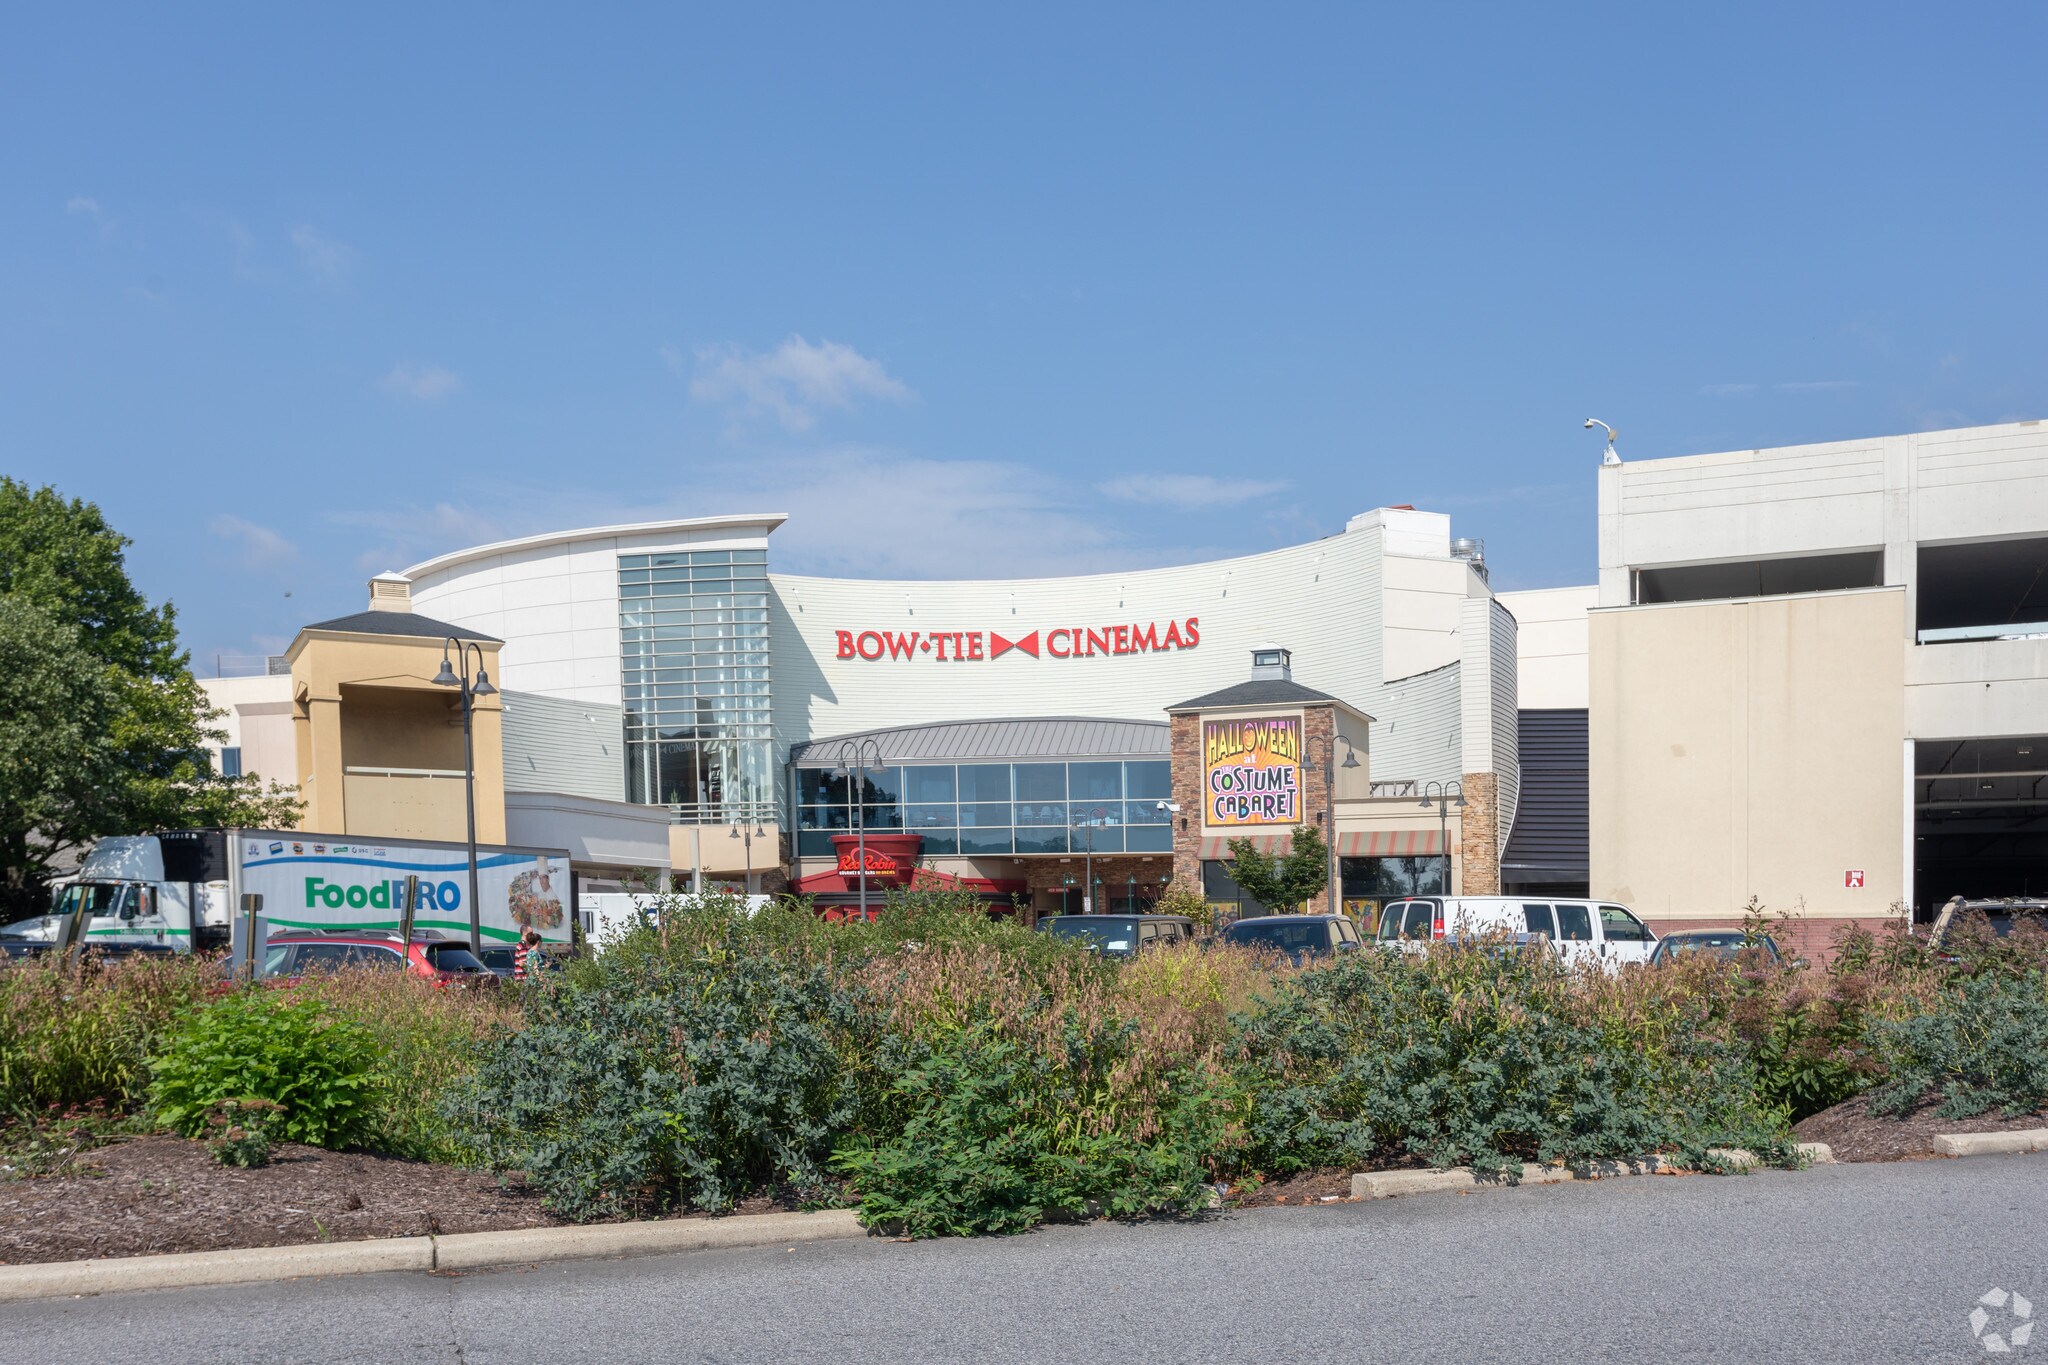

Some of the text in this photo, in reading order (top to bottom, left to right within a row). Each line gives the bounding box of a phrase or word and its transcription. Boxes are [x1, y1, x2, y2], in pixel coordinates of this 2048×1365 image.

[1047, 617, 1200, 658] CINEMAS
[668, 742, 698, 754] CINEMA
[1208, 720, 1298, 767] HALLOWEEN
[1244, 754, 1257, 764] at
[1211, 766, 1294, 793] COSTUME
[1215, 788, 1296, 819] CABARET
[863, 854, 897, 871] Robin
[305, 877, 461, 912] FoodPRO
